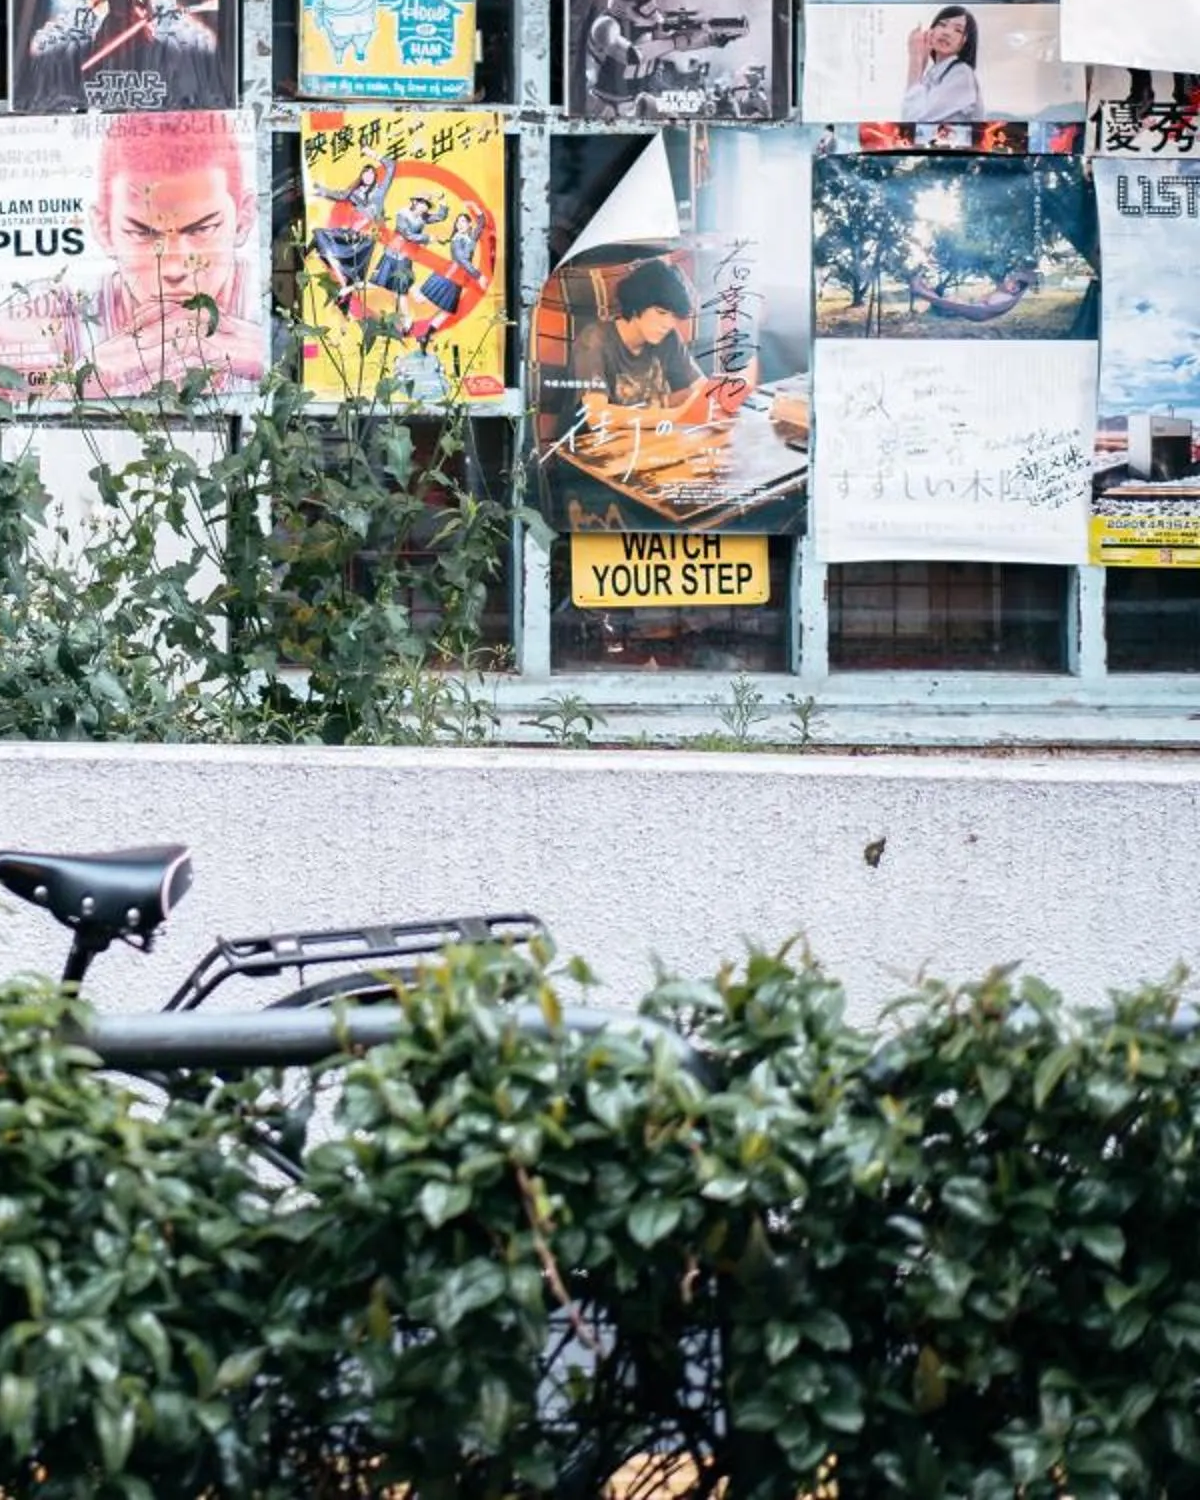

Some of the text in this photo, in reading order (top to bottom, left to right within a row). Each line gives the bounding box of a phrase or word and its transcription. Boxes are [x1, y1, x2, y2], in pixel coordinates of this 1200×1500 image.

[84, 70, 167, 90] STAR
[85, 88, 167, 109] WARS
[1090, 100, 1199, 152] 優秀
[38, 197, 83, 213] DUNK
[623, 534, 721, 560] WATCH
[592, 562, 754, 597] YOUR STEP
